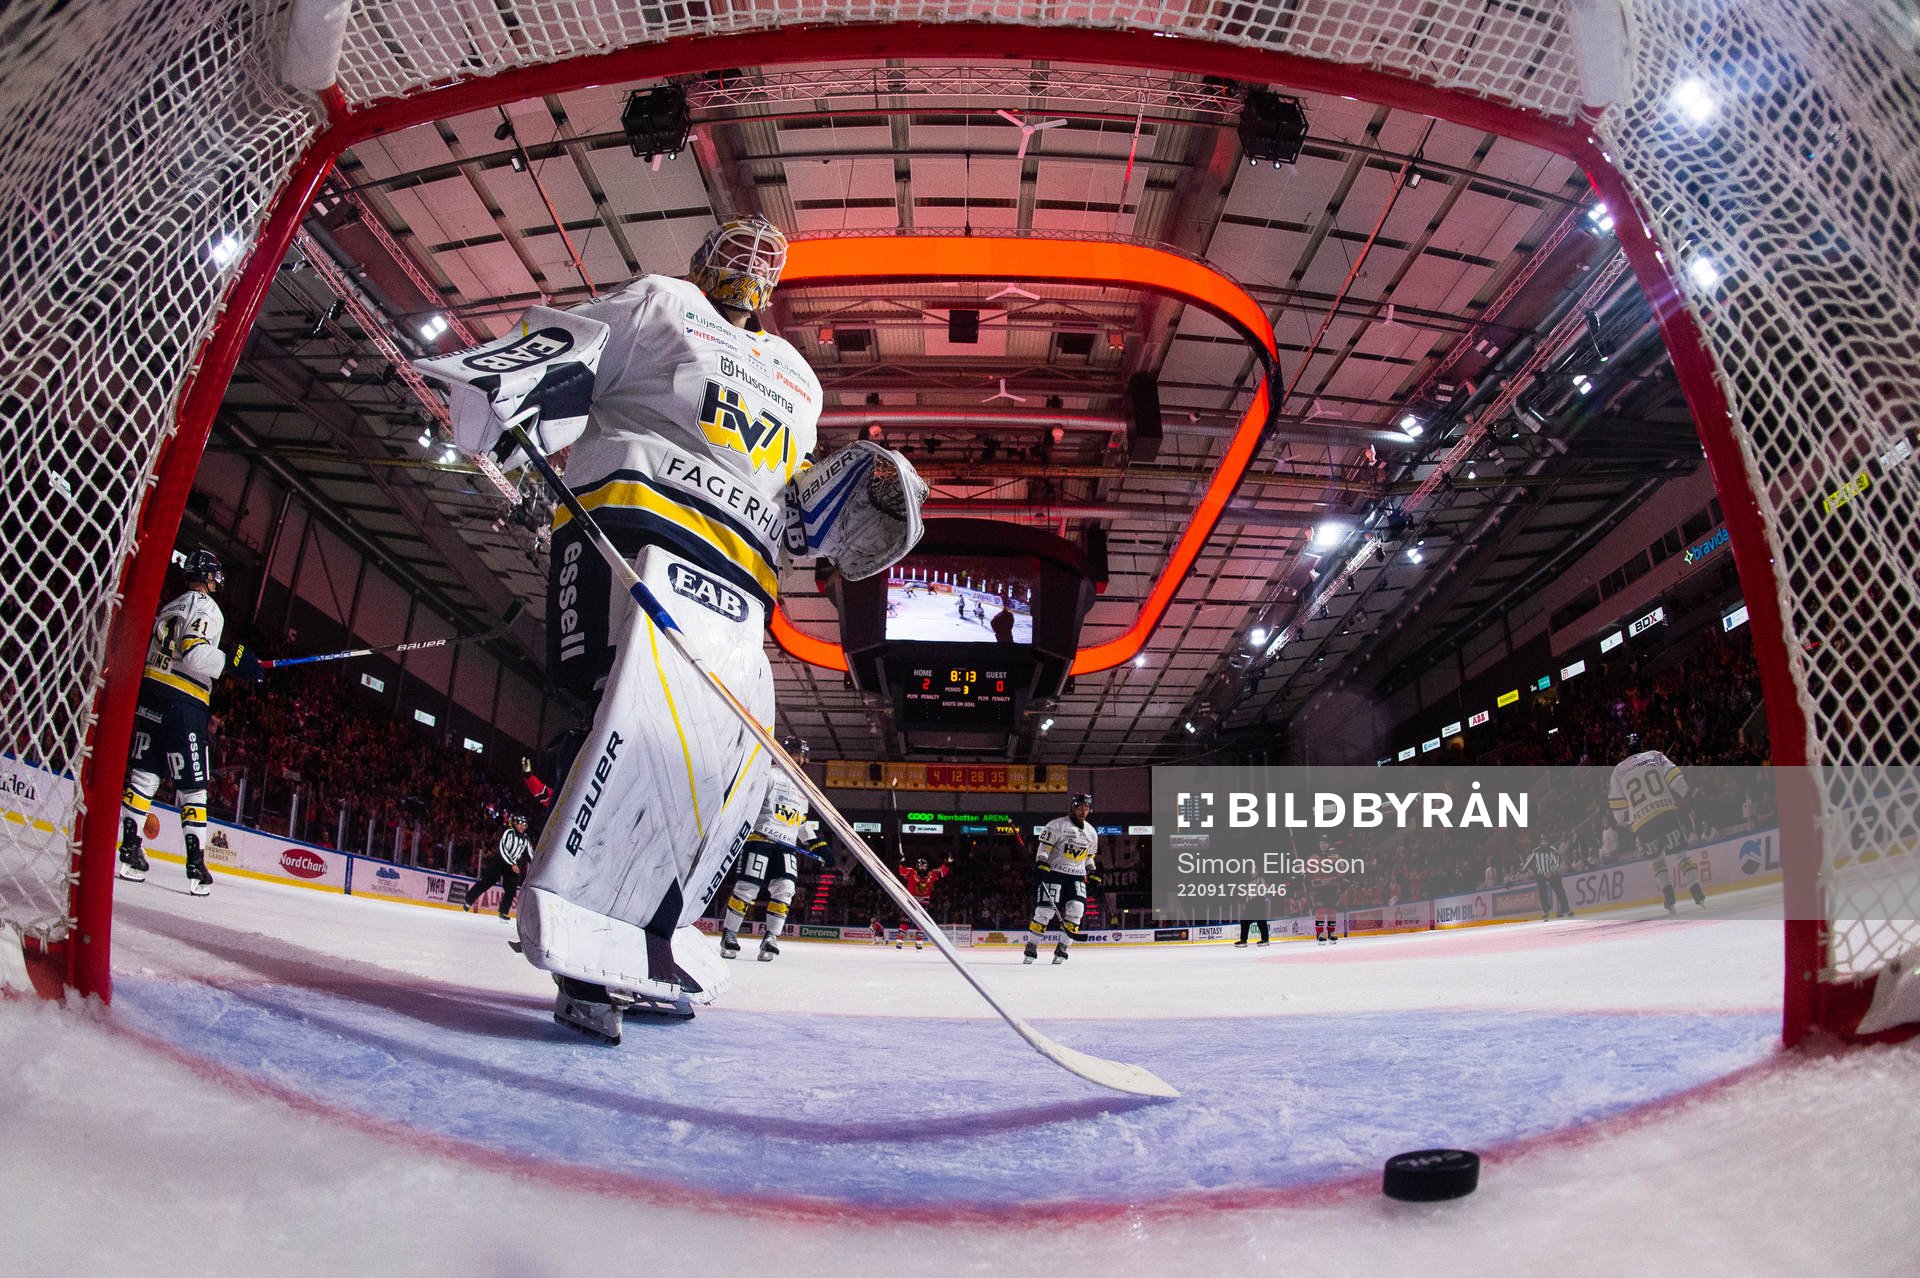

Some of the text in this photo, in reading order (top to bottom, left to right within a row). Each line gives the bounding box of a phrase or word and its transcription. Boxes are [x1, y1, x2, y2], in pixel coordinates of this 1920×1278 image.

[693, 329, 738, 351] INTERSPORT
[471, 334, 568, 371] EAB
[735, 364, 794, 414] Husqvarna
[776, 371, 812, 403] Passera
[699, 379, 791, 465] HV71
[802, 450, 854, 505] BAUER
[666, 456, 785, 549] FAGERHU
[1692, 528, 1729, 560] bravida
[675, 566, 744, 618] EAB
[558, 541, 585, 662] essell
[190, 618, 208, 636] 41
[913, 669, 933, 677] HOME
[950, 670, 977, 683] 8:13
[985, 671, 1008, 679] GUEST
[922, 678, 931, 690] 2
[963, 685, 969, 694] 3
[996, 680, 1004, 692] 0
[1472, 713, 1486, 725] ABB
[188, 732, 204, 782] essell
[952, 770, 962, 782] 12
[971, 770, 985, 783] 28
[991, 771, 1005, 783] 35
[565, 730, 625, 857] BAUER
[1626, 768, 1664, 807] 20
[907, 813, 1009, 822] coop Norrbotten ARENA
[1040, 830, 1051, 841] 21
[702, 820, 751, 905] BAUER
[1575, 870, 1624, 906] SSAB
[1436, 907, 1461, 923] NIEMI
[801, 927, 838, 938] Derome
[1199, 927, 1223, 935] FANTASY
